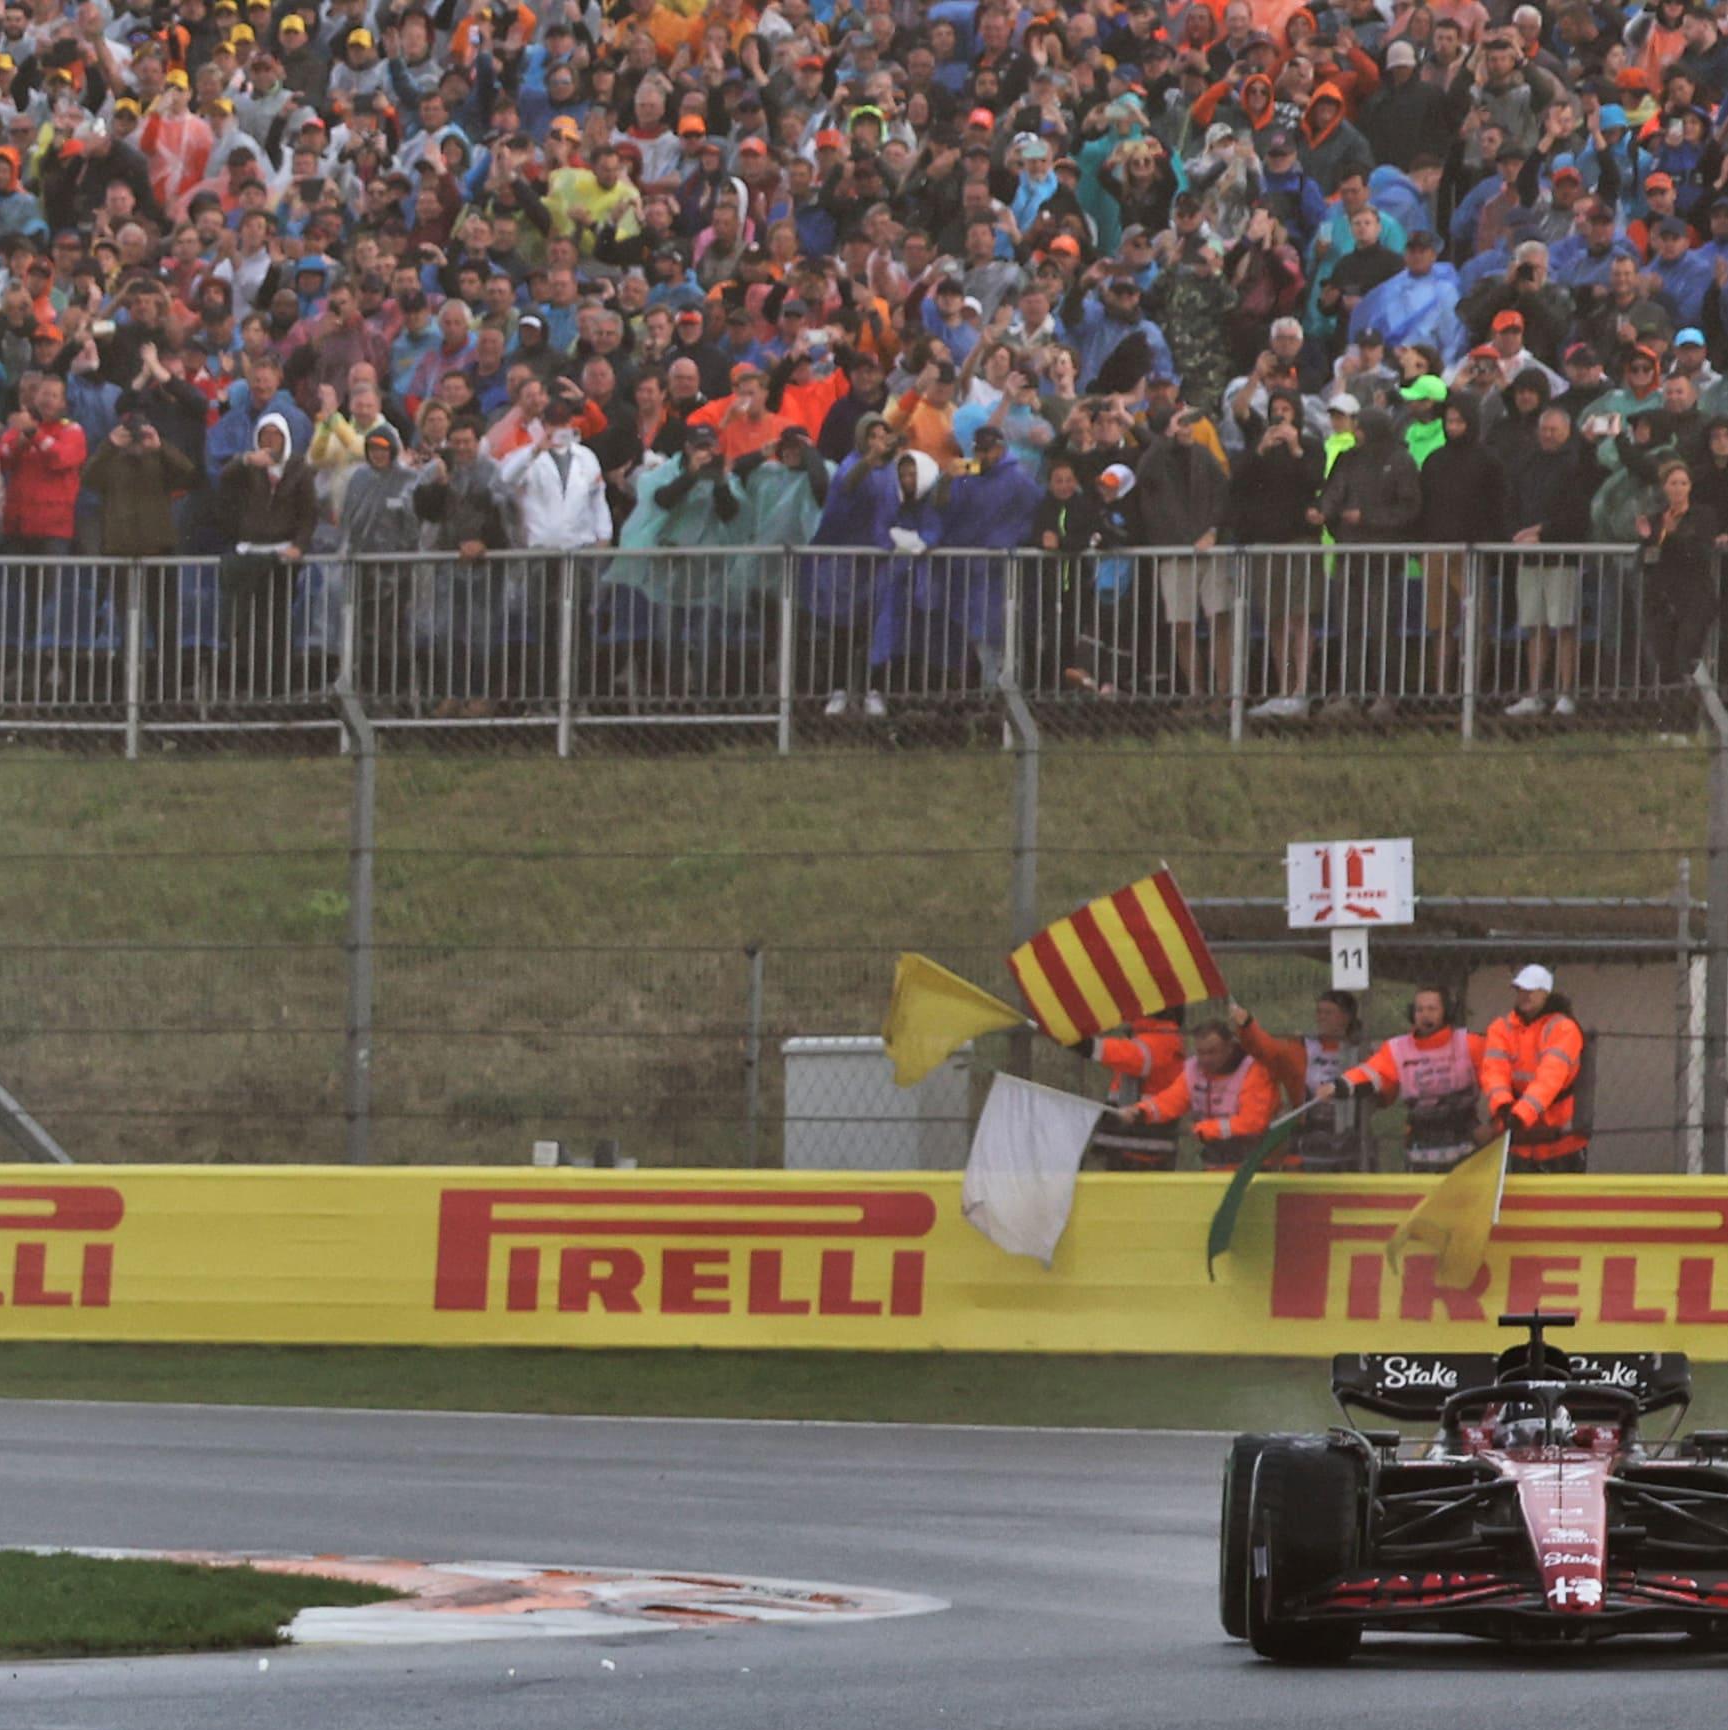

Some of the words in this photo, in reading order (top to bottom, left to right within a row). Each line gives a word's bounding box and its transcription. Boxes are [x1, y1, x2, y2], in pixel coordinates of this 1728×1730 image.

[1338, 948, 1363, 970] 11
[432, 1188, 937, 1317] PIRELLI
[1270, 1193, 1728, 1323] PIRELL
[1383, 1356, 1459, 1389] Stake
